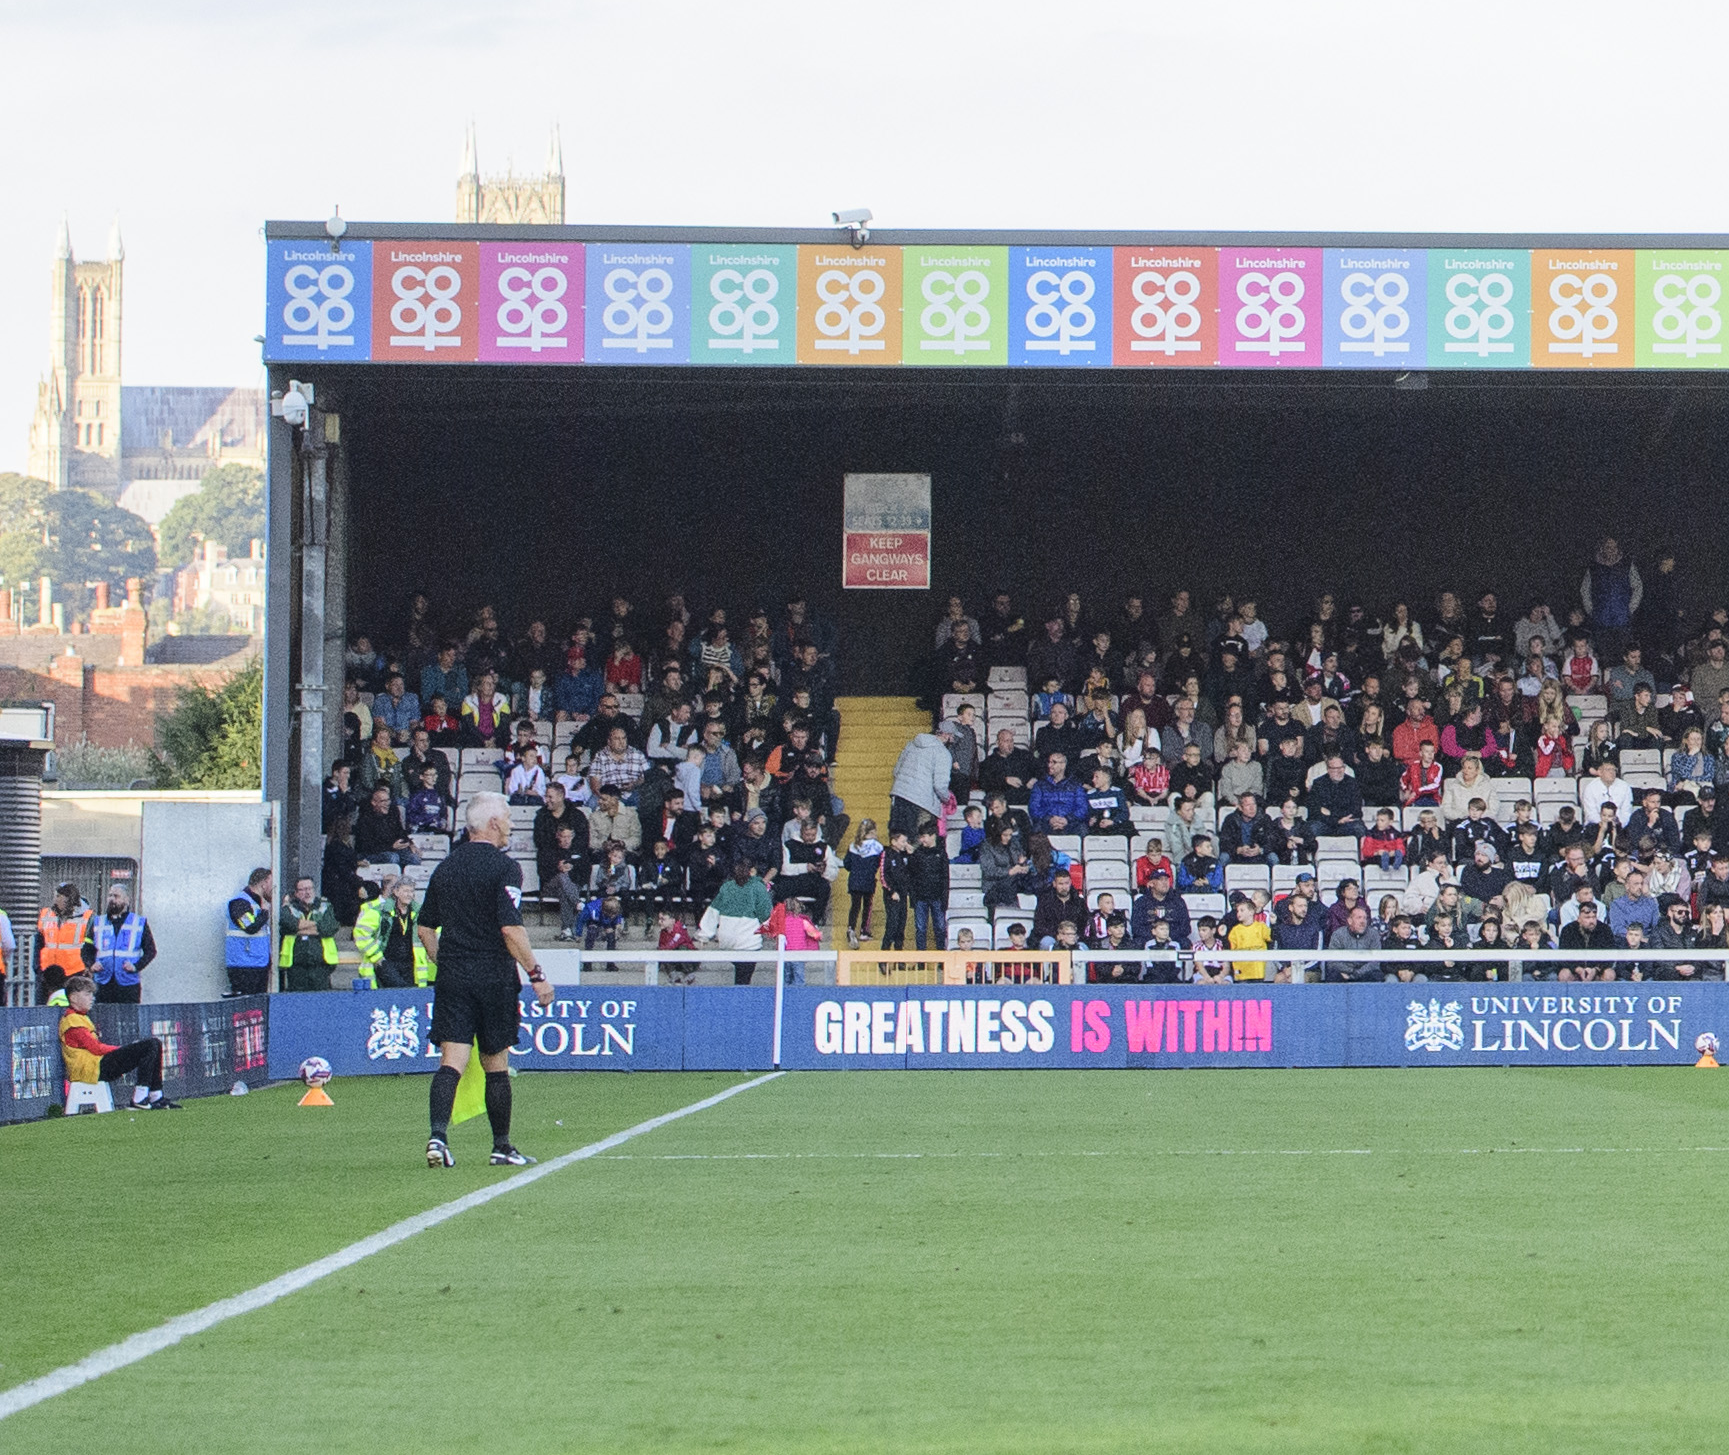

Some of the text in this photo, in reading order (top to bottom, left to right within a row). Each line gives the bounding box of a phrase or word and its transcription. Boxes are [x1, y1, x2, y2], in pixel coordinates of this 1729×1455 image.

[283, 250, 356, 262] Lincolnshire
[390, 251, 463, 263] Lincolnshire
[497, 252, 569, 264] Lincolnshire
[603, 254, 674, 265] Lincolnshire
[709, 254, 780, 265] Lincolnshire
[815, 255, 886, 267] Lincolnshire
[920, 256, 992, 267] Lincolnshire
[1025, 256, 1096, 267] Lincolnshire
[1131, 256, 1202, 268] Lincolnshire
[1235, 257, 1306, 269] Lincolnshire
[1340, 258, 1410, 269] Lincolnshire
[1444, 259, 1515, 270] Lincolnshire
[1548, 259, 1618, 271] Lincolnshire
[1652, 259, 1723, 271] Lincolnshire
[870, 538, 902, 549] KEEP
[851, 553, 923, 565] GANGWAYS
[866, 569, 907, 581] CLEAR
[601, 1000, 637, 1018] OF
[1471, 996, 1682, 1015] UNIVERSITY OF
[815, 999, 1272, 1055] GREATNESS IS WITHIN
[1472, 1019, 1681, 1052] LINCOLN
